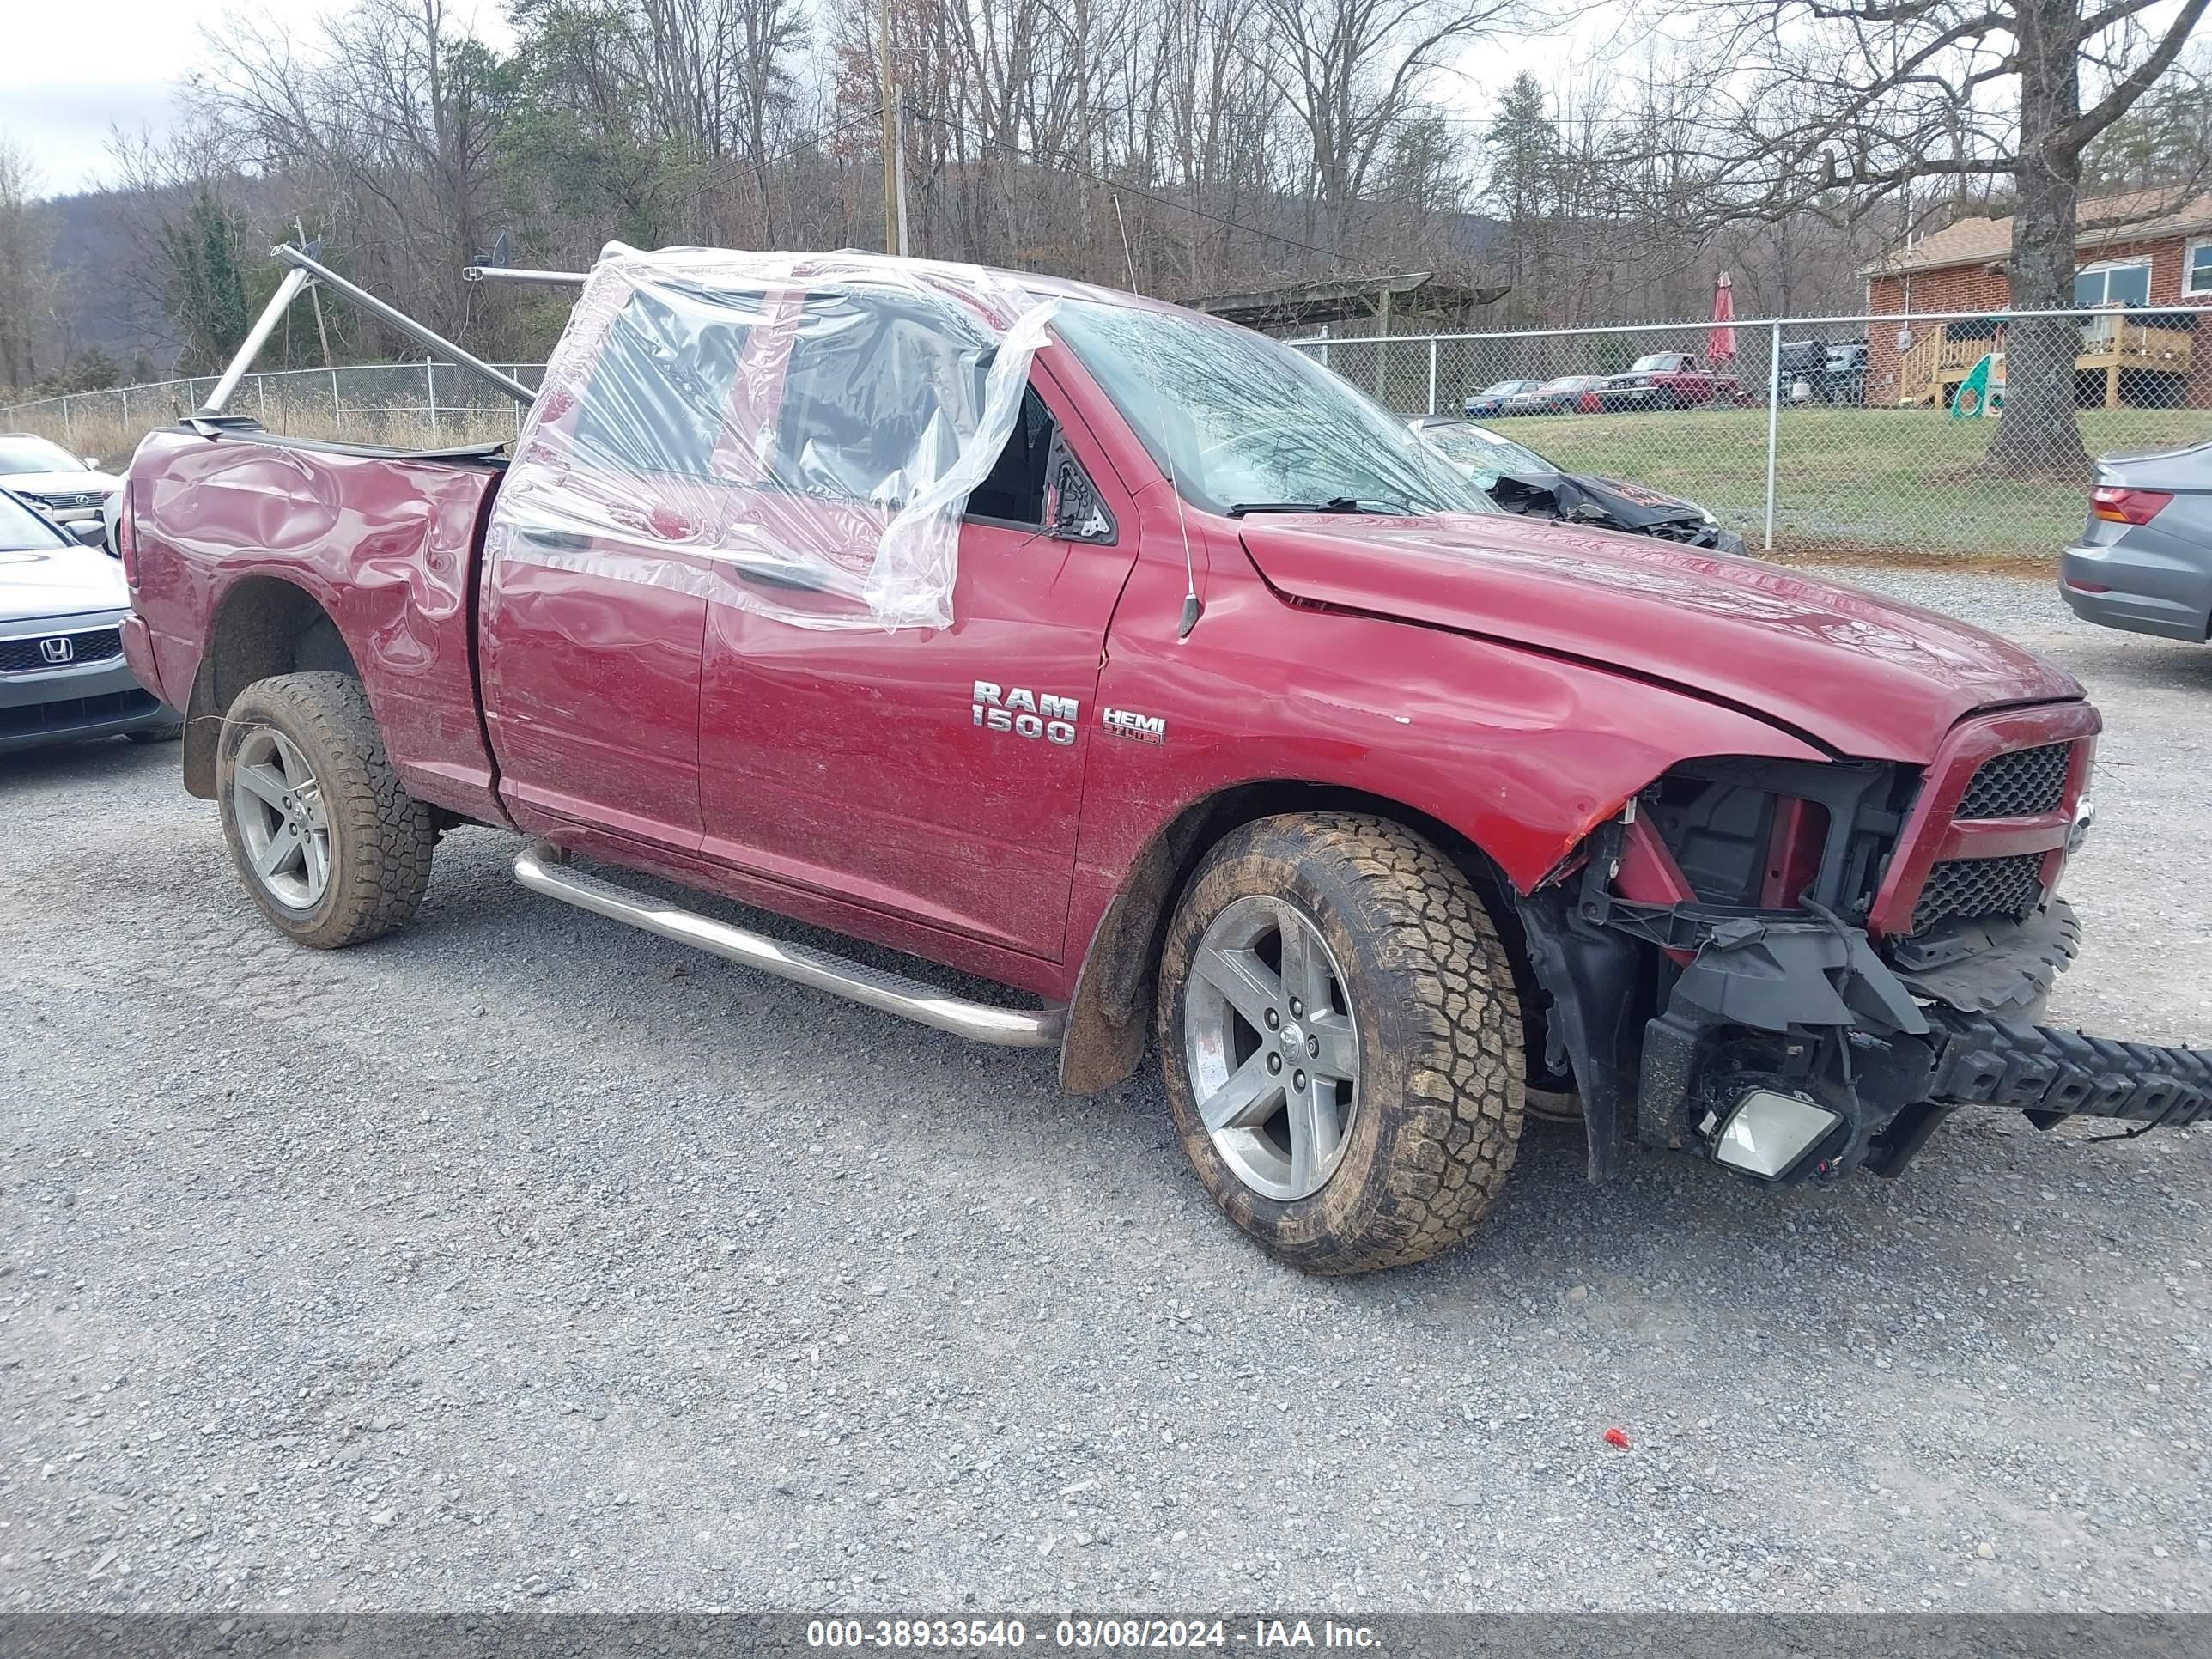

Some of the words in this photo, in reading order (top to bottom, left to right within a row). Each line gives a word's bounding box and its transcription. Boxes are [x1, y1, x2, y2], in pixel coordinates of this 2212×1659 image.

[973, 679, 1079, 721] RAM
[972, 703, 1076, 746] 1500
[1103, 707, 1166, 733] HEMI
[1125, 727, 1159, 744] LITER
